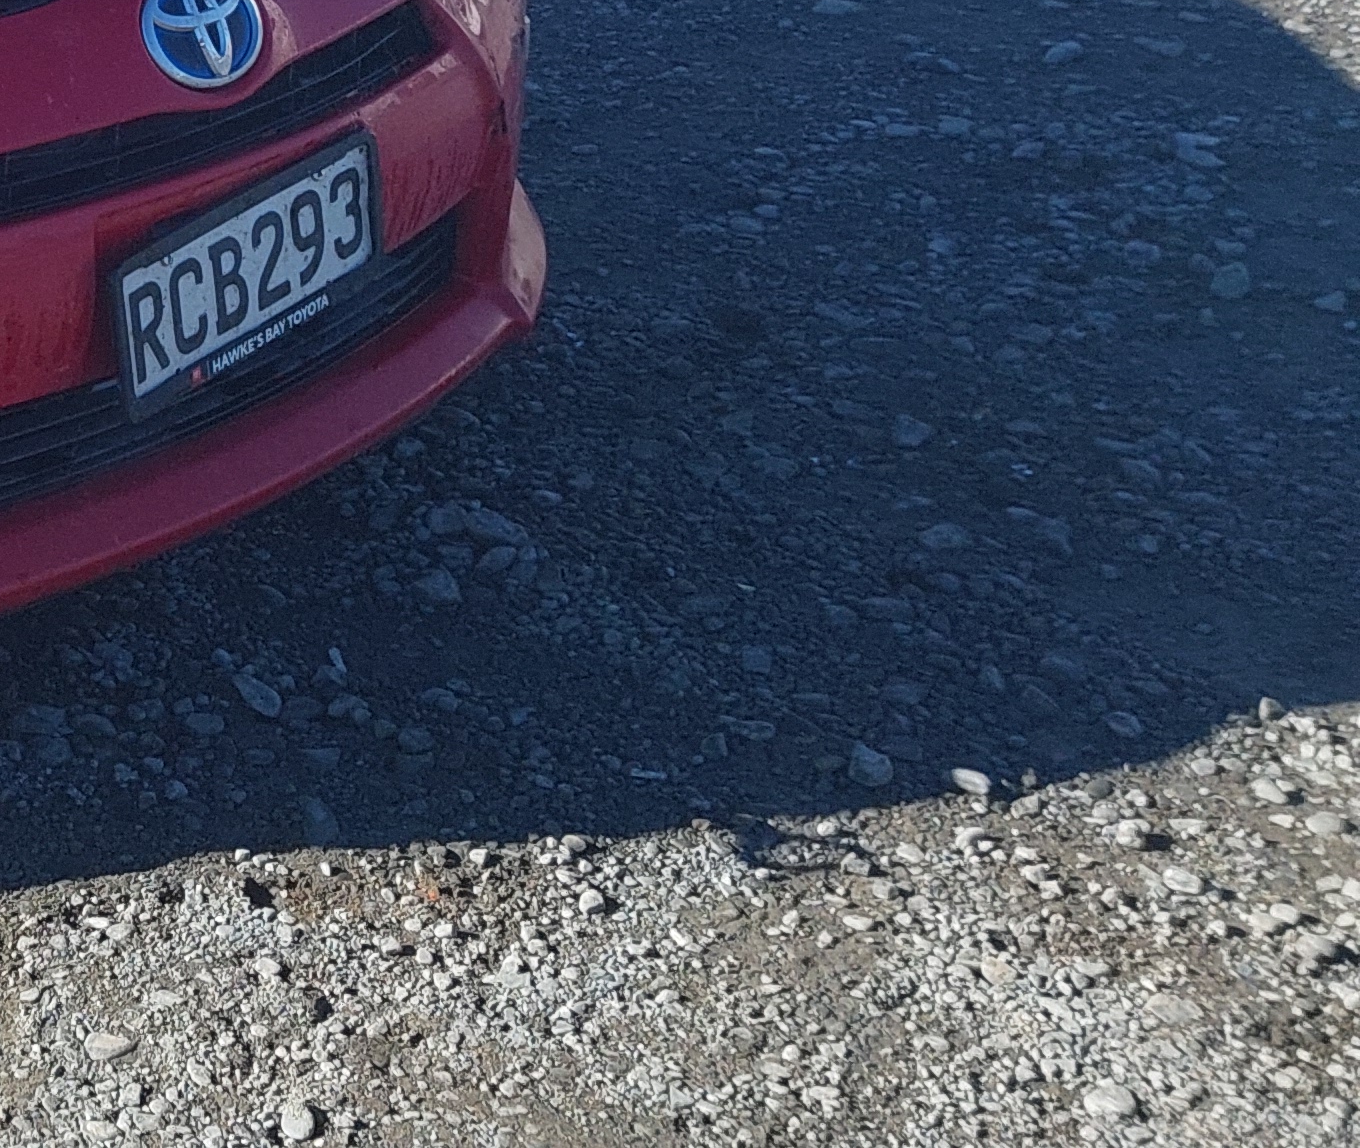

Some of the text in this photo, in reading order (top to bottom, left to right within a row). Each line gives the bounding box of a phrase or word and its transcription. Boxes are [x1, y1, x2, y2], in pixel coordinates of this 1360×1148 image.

[128, 167, 363, 385] RCB293
[212, 293, 330, 374] HAWKE'S BAY TOYOTA
